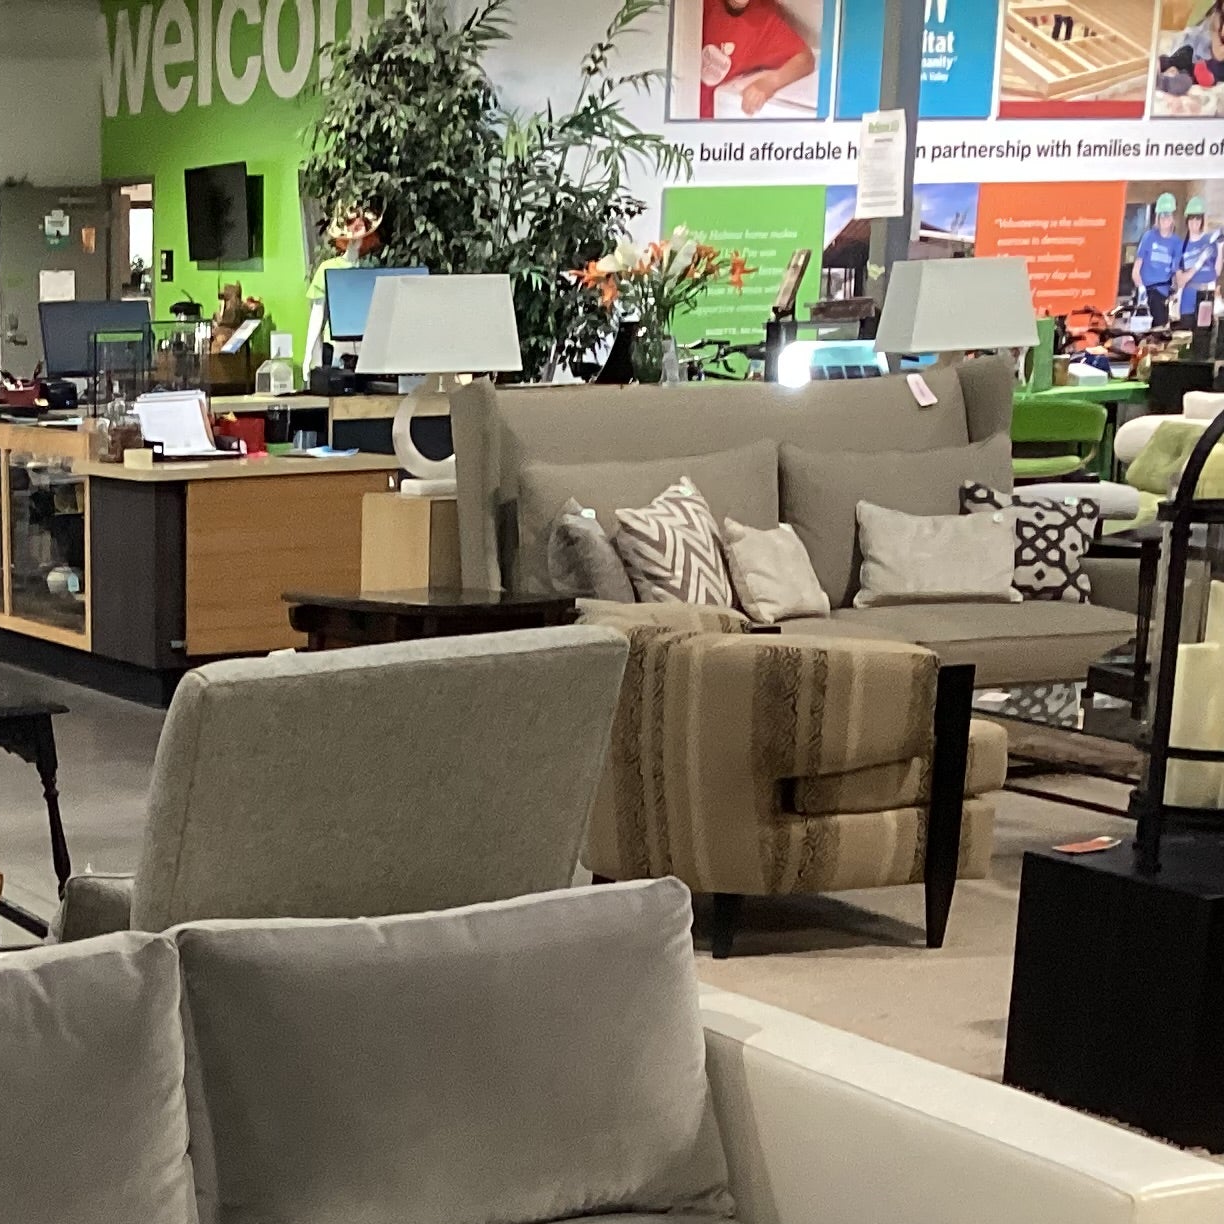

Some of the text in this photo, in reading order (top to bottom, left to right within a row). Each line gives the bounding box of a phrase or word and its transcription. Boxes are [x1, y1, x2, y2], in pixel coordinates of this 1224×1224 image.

[923, 29, 955, 53] itat
[700, 143, 744, 161] build
[750, 141, 842, 161] affordable
[931, 139, 1032, 162] partnership
[1036, 139, 1072, 158] with
[1077, 138, 1141, 158] families
[1145, 138, 1160, 157] in
[1164, 138, 1205, 156] need
